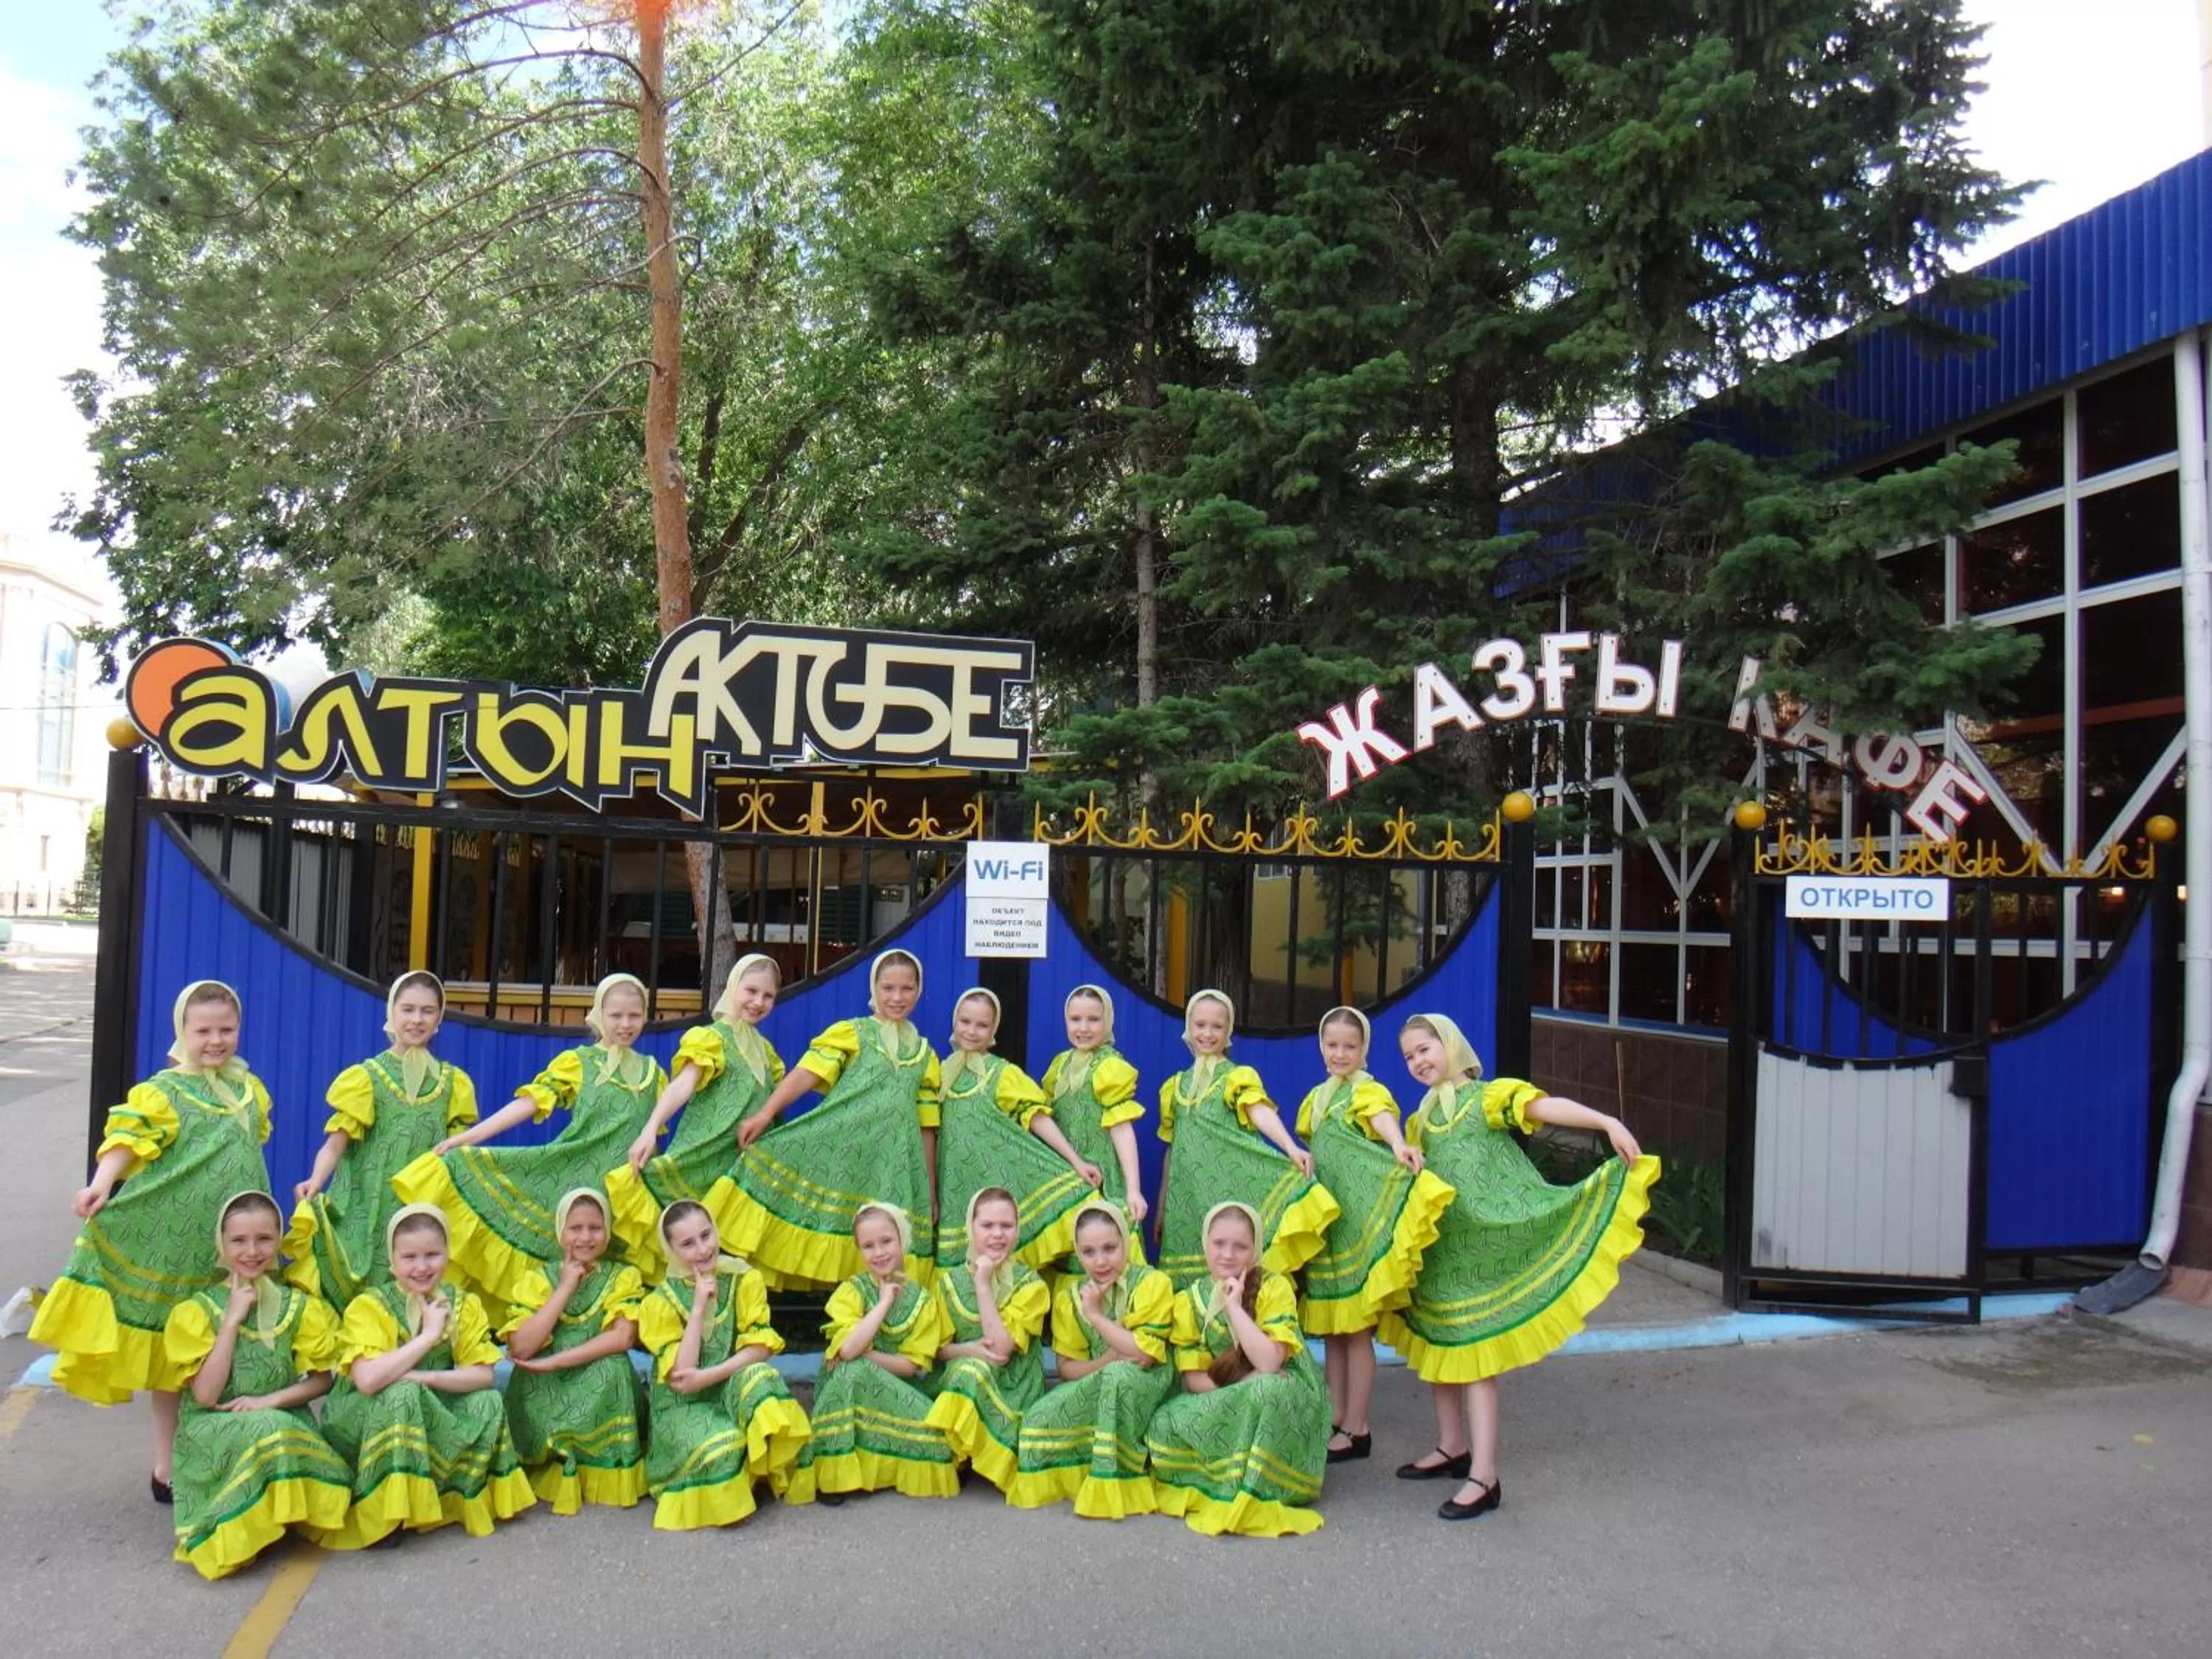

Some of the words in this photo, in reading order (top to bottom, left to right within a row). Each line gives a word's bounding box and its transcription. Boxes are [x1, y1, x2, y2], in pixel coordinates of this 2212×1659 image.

[1296, 630, 1683, 799] ЖАЗҒЫ
[973, 859, 1043, 881] Wi-Fi
[1801, 887, 1934, 909] ОТКРЫТО
